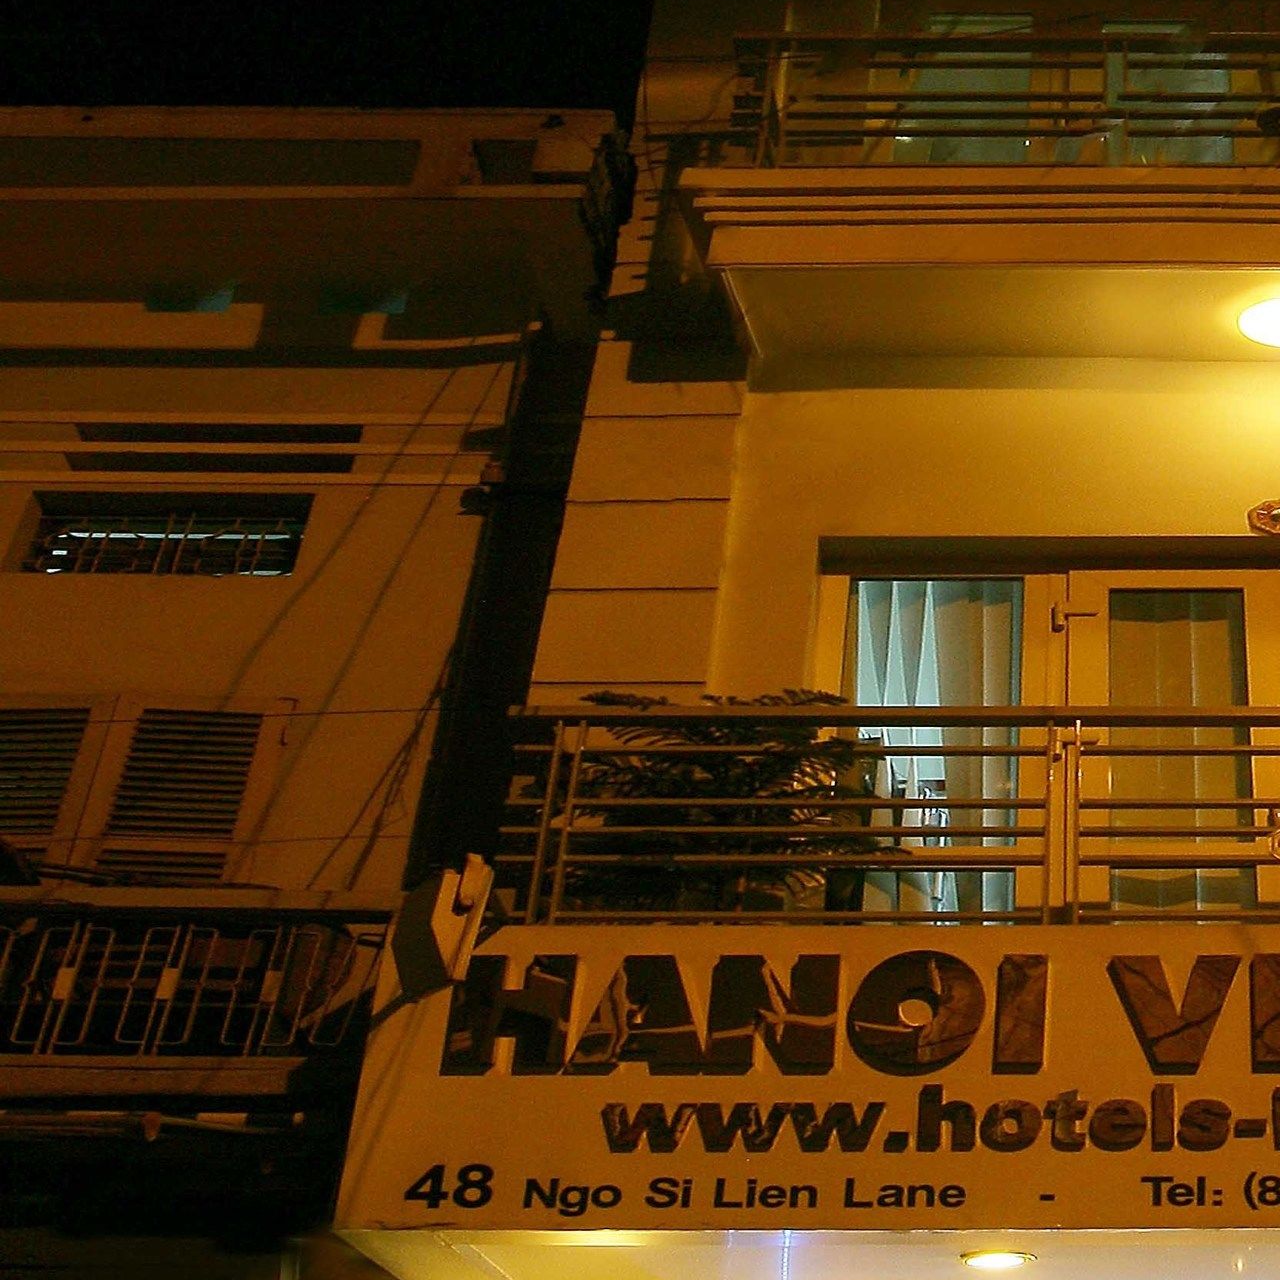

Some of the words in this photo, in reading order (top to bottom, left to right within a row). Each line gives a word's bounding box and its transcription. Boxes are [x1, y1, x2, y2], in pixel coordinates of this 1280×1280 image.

[440, 949, 1049, 1077] HANOI
[404, 1164, 494, 1210] 48
[523, 1177, 622, 1218] Ngo
[644, 1176, 693, 1210] Si
[713, 1175, 820, 1210] Lien
[843, 1177, 966, 1210] Lane
[1141, 1175, 1224, 1209] Tel:
